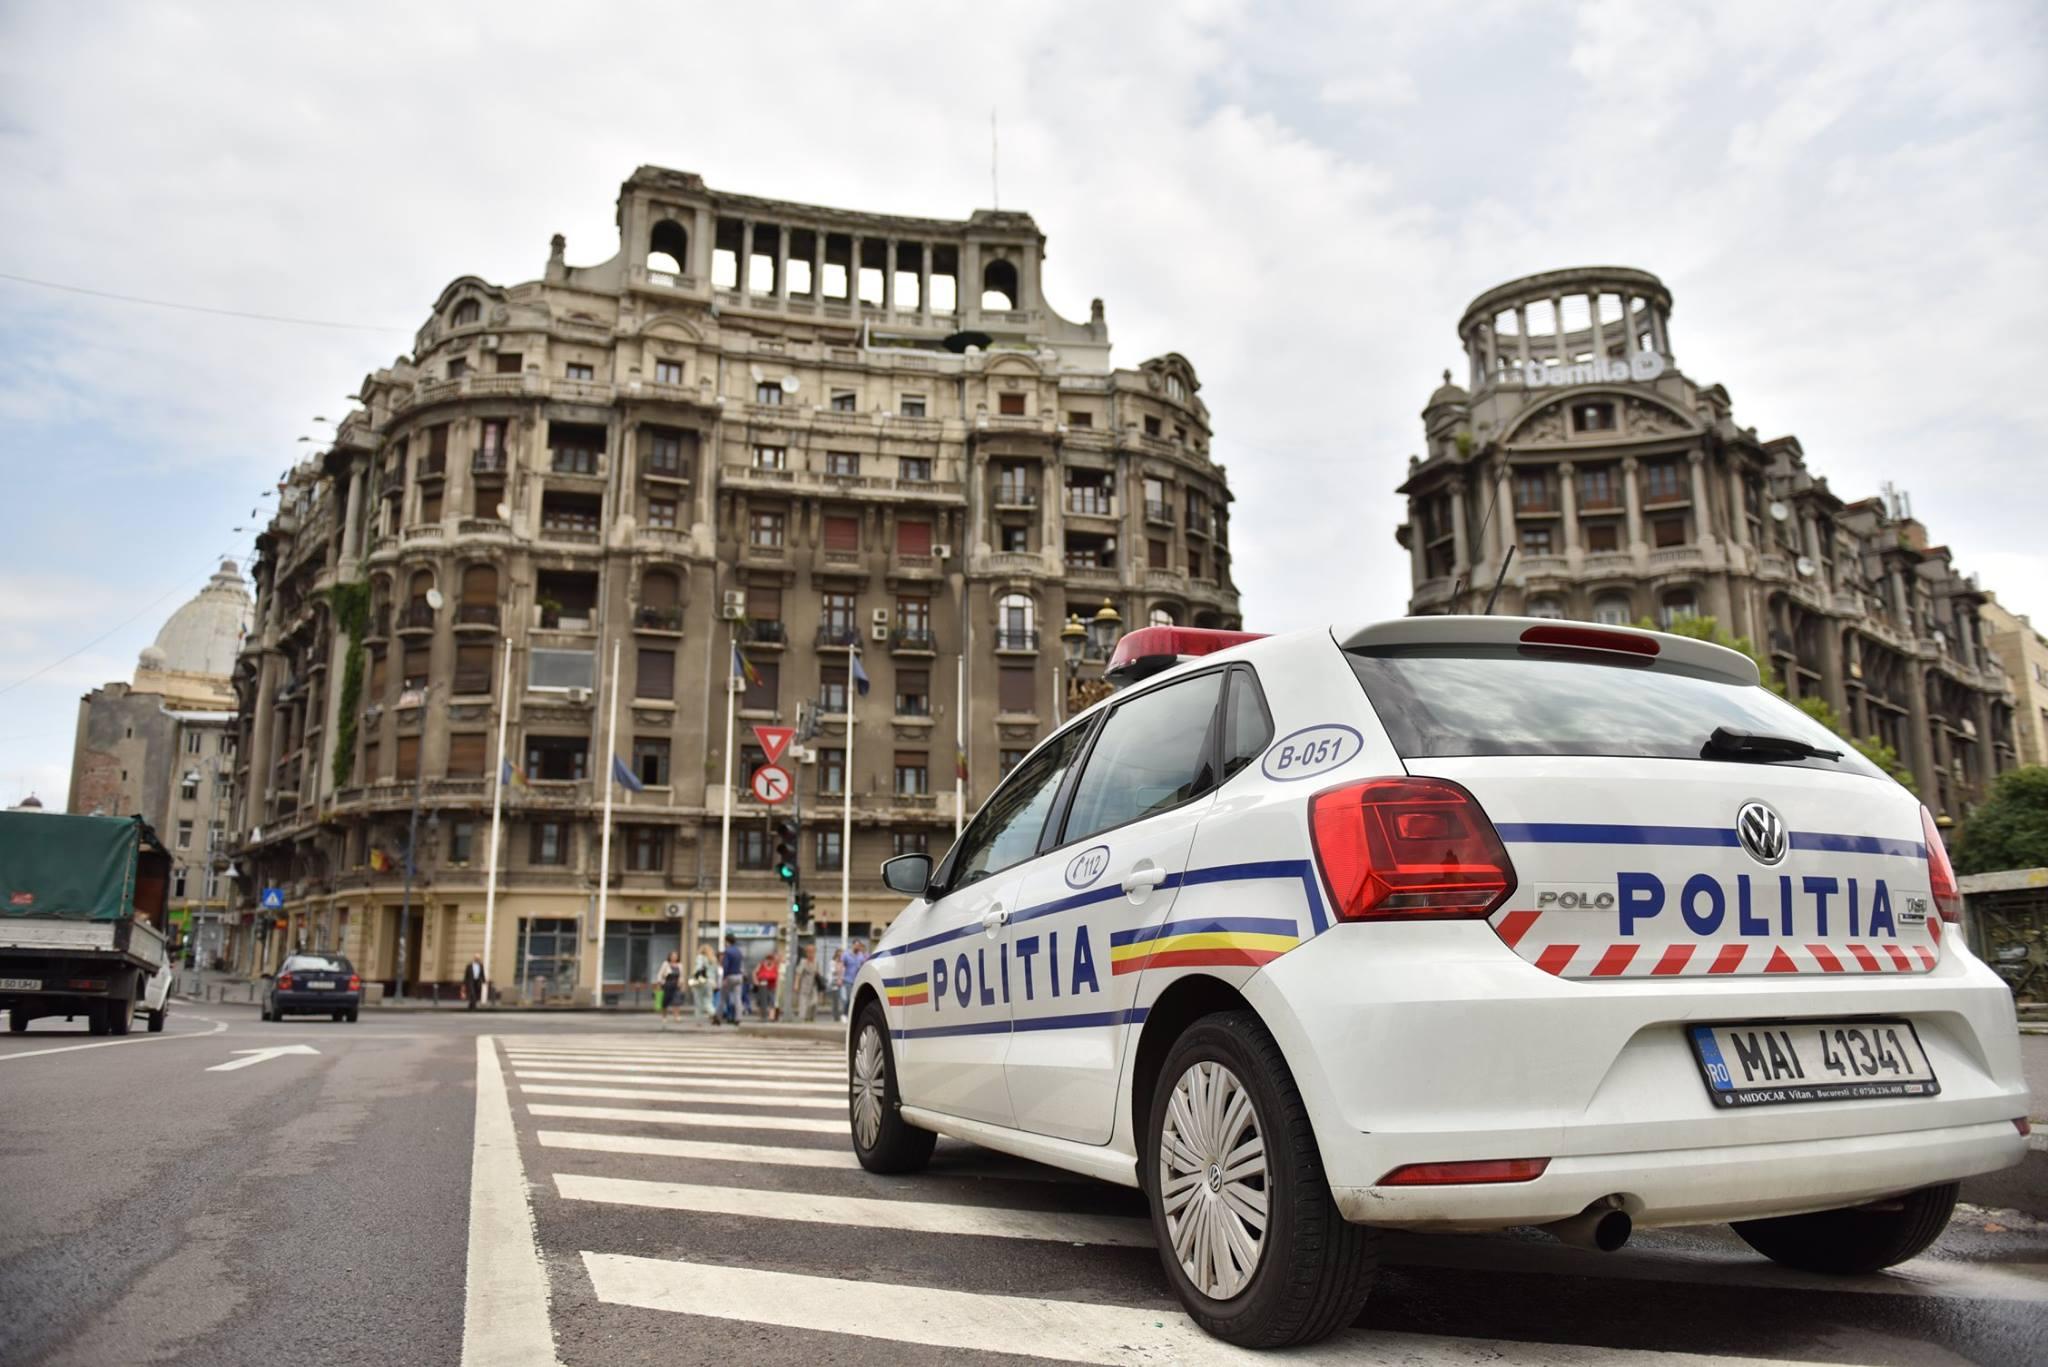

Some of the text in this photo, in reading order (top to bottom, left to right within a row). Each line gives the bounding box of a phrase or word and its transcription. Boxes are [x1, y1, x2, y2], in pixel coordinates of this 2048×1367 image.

[1277, 736, 1343, 770] B-051
[1083, 855, 1101, 878] 112
[1537, 891, 1615, 909] POLO
[1616, 872, 1897, 937] POLITIA
[933, 924, 1100, 1012] POLITIA
[1707, 1029, 1914, 1082] RO MAI 41341
[1739, 1090, 1786, 1103] MIDOCAR
